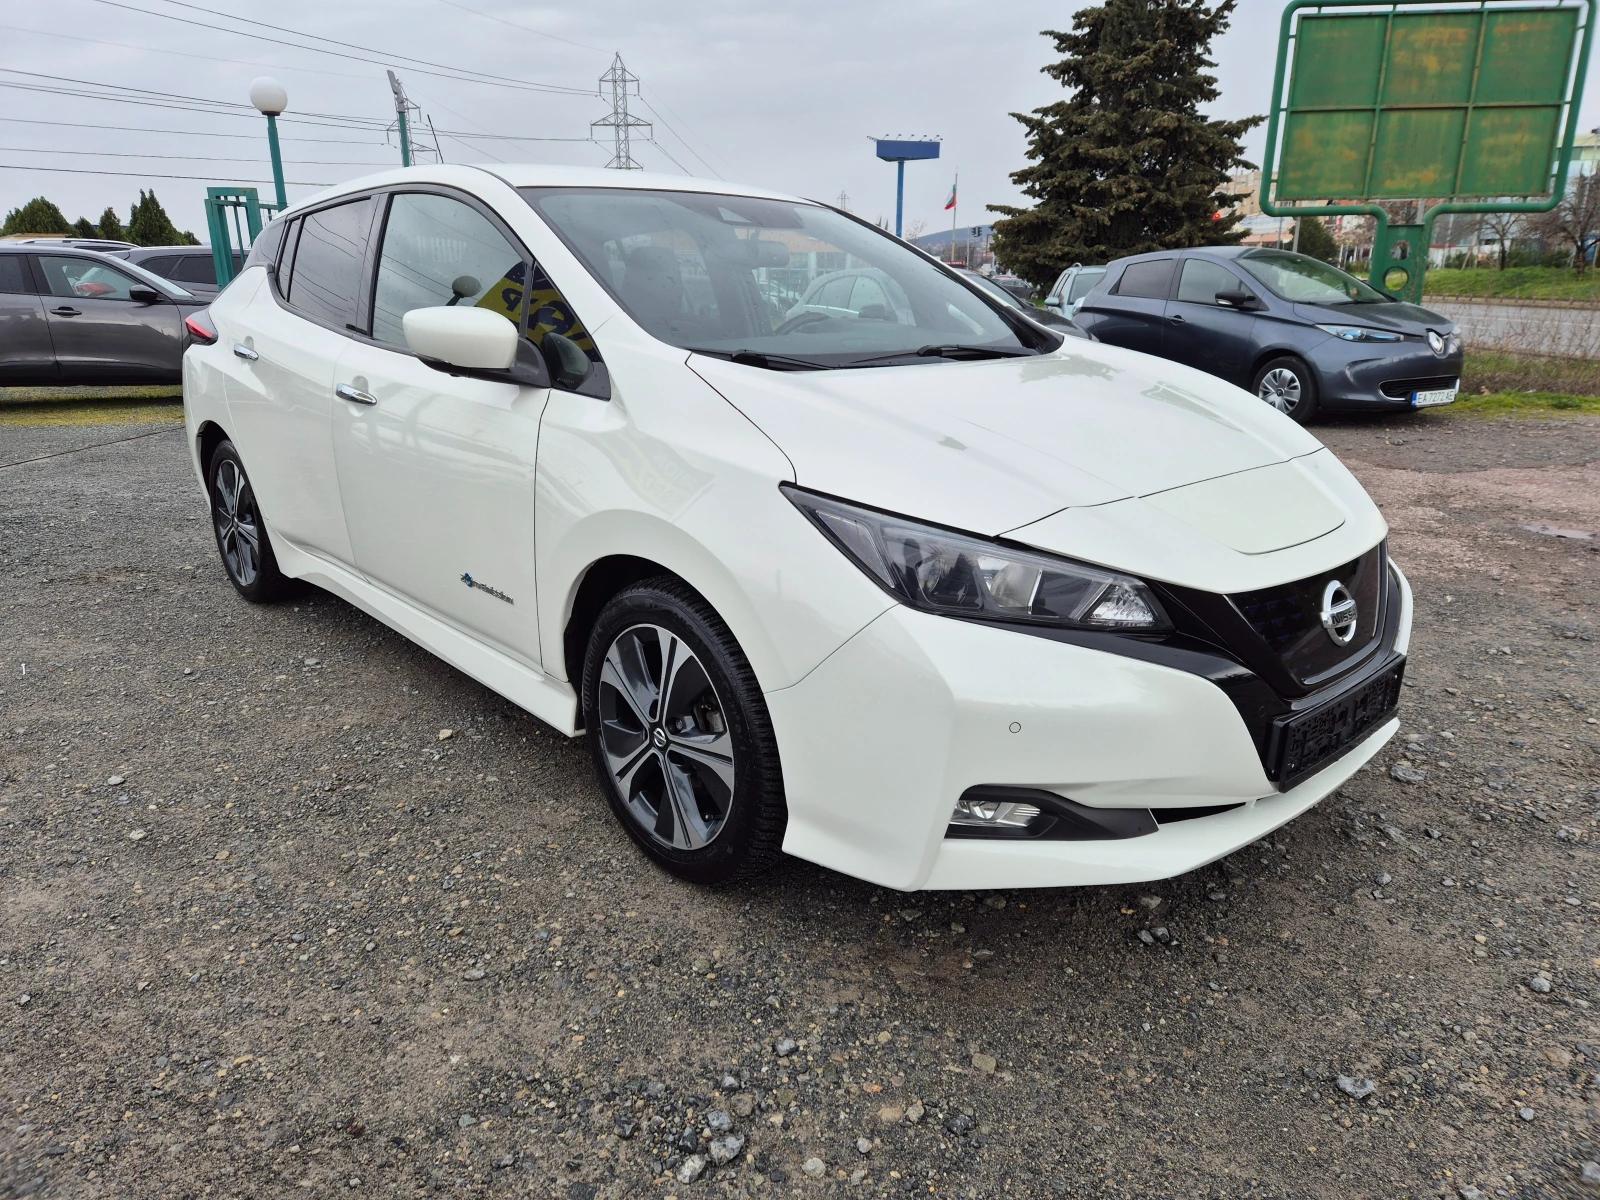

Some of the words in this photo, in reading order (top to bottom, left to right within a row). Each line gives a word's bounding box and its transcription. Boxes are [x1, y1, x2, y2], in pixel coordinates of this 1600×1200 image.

[1417, 393, 1427, 403] EA
[1428, 391, 1445, 402] 7272
[1445, 390, 1454, 400] AE
